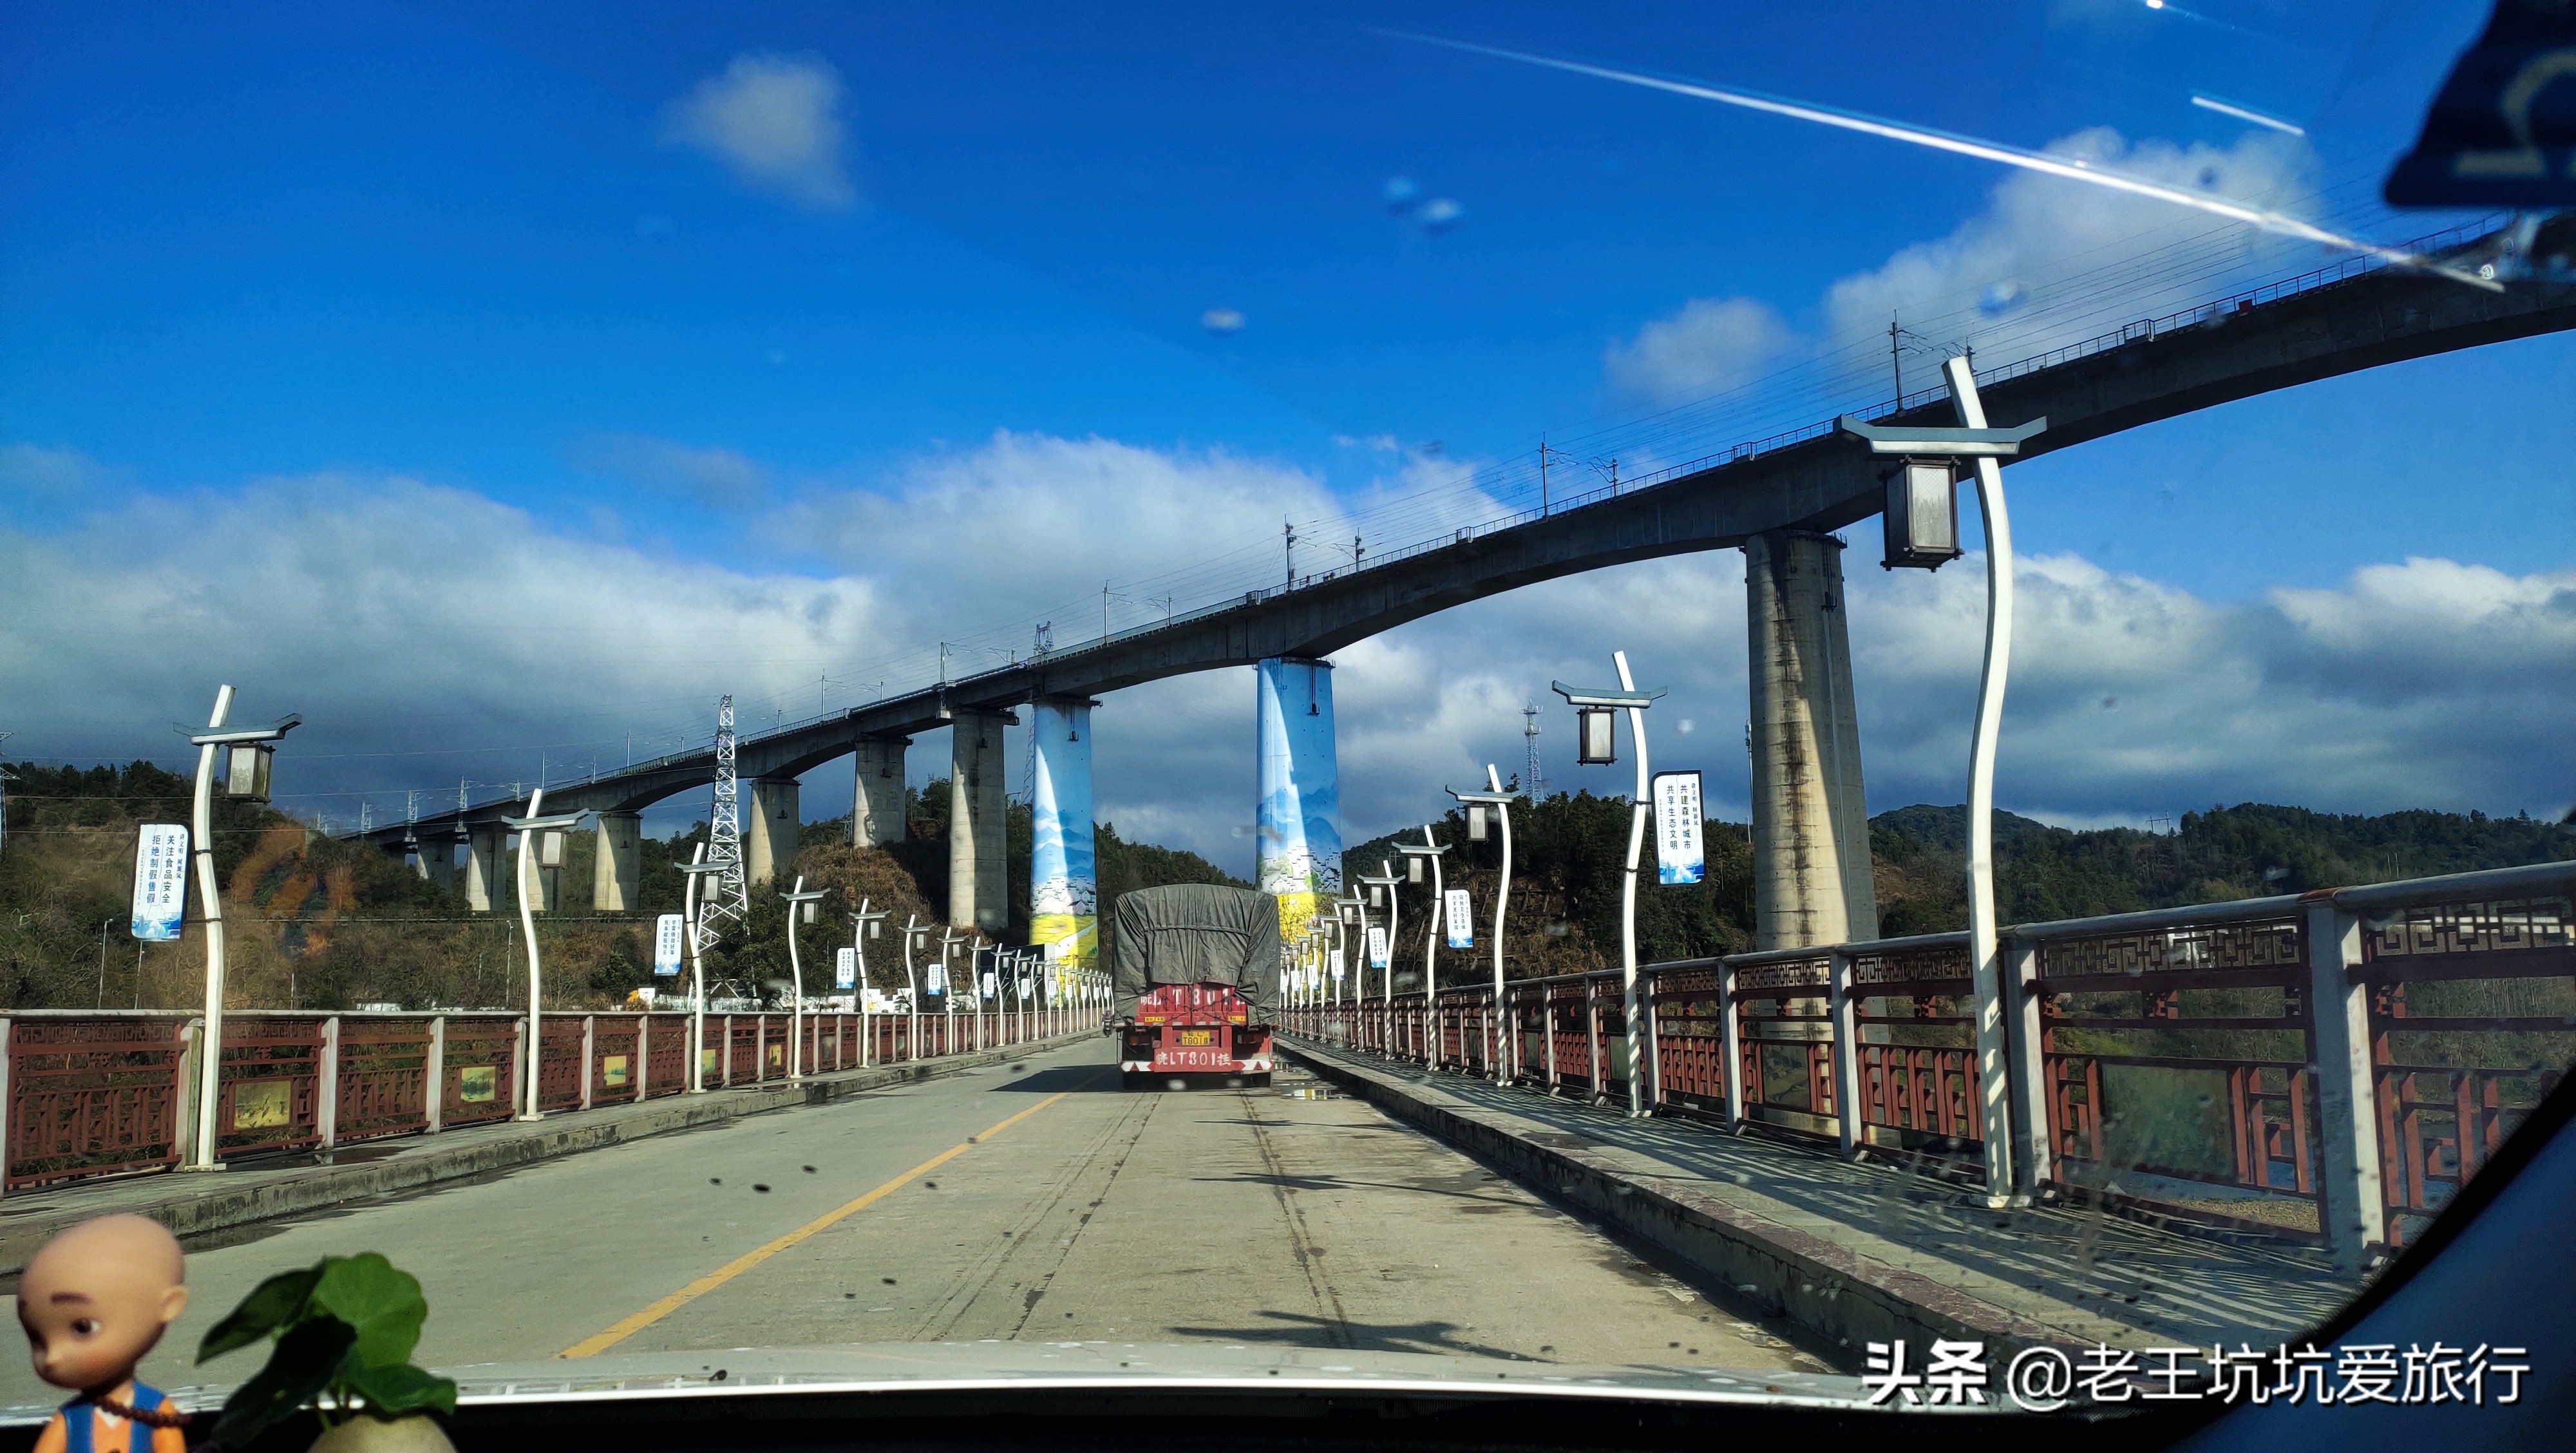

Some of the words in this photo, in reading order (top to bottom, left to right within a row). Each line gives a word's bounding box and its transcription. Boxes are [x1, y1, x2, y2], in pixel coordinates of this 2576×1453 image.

[1666, 784, 1678, 850] 共享生态文明
[1680, 784, 1692, 850] 共建森林城市
[147, 835, 161, 904] 拒绝制假售假
[162, 834, 175, 904] 关注食品安全
[1156, 1051, 1231, 1066] 皖LT801挂
